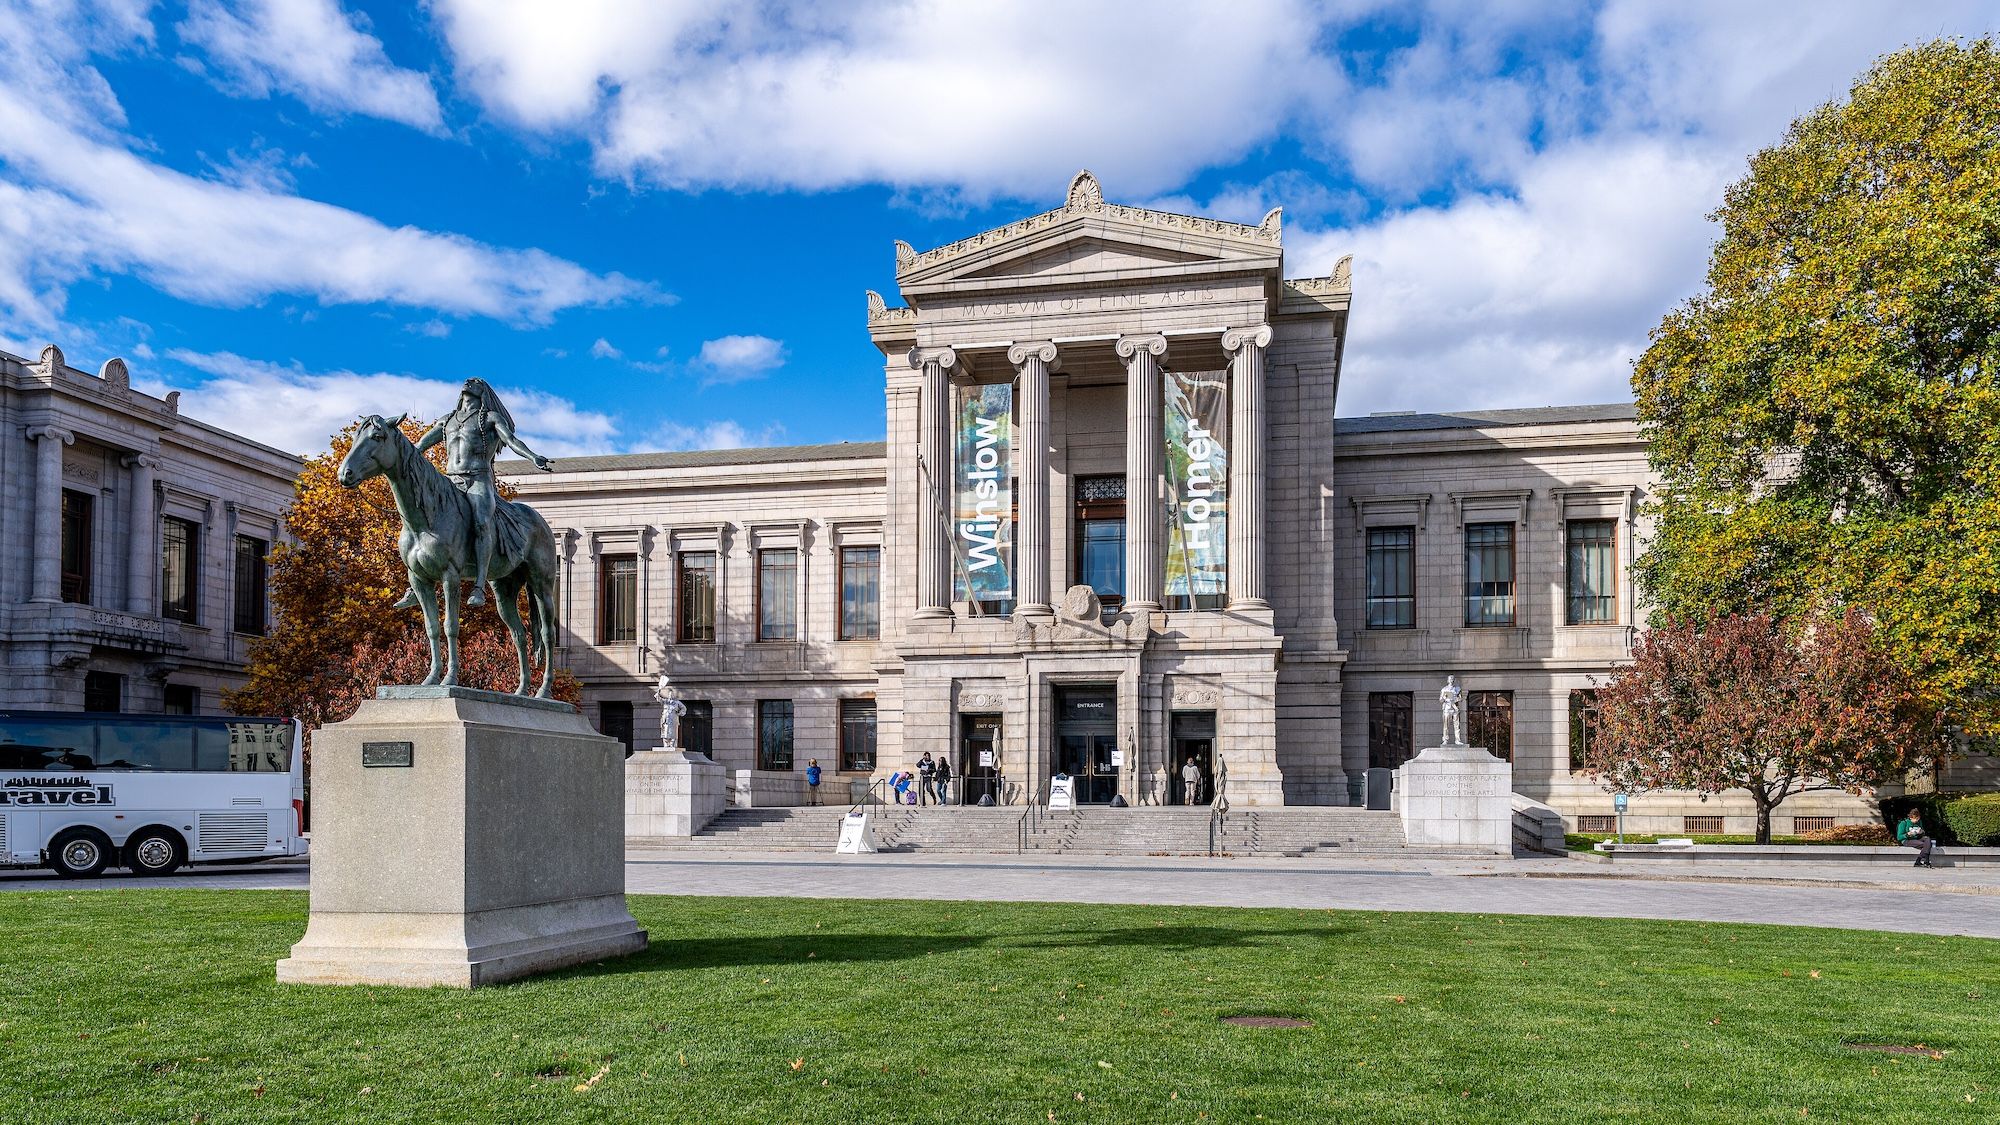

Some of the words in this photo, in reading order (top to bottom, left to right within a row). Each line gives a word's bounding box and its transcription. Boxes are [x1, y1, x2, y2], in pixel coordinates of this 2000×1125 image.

[962, 298, 1047, 317] MVSEVM
[1060, 296, 1085, 311] OF
[1099, 290, 1148, 308] FINE
[1161, 286, 1214, 303] ARTS
[960, 417, 998, 572] Winslow
[1180, 418, 1211, 549] Homer
